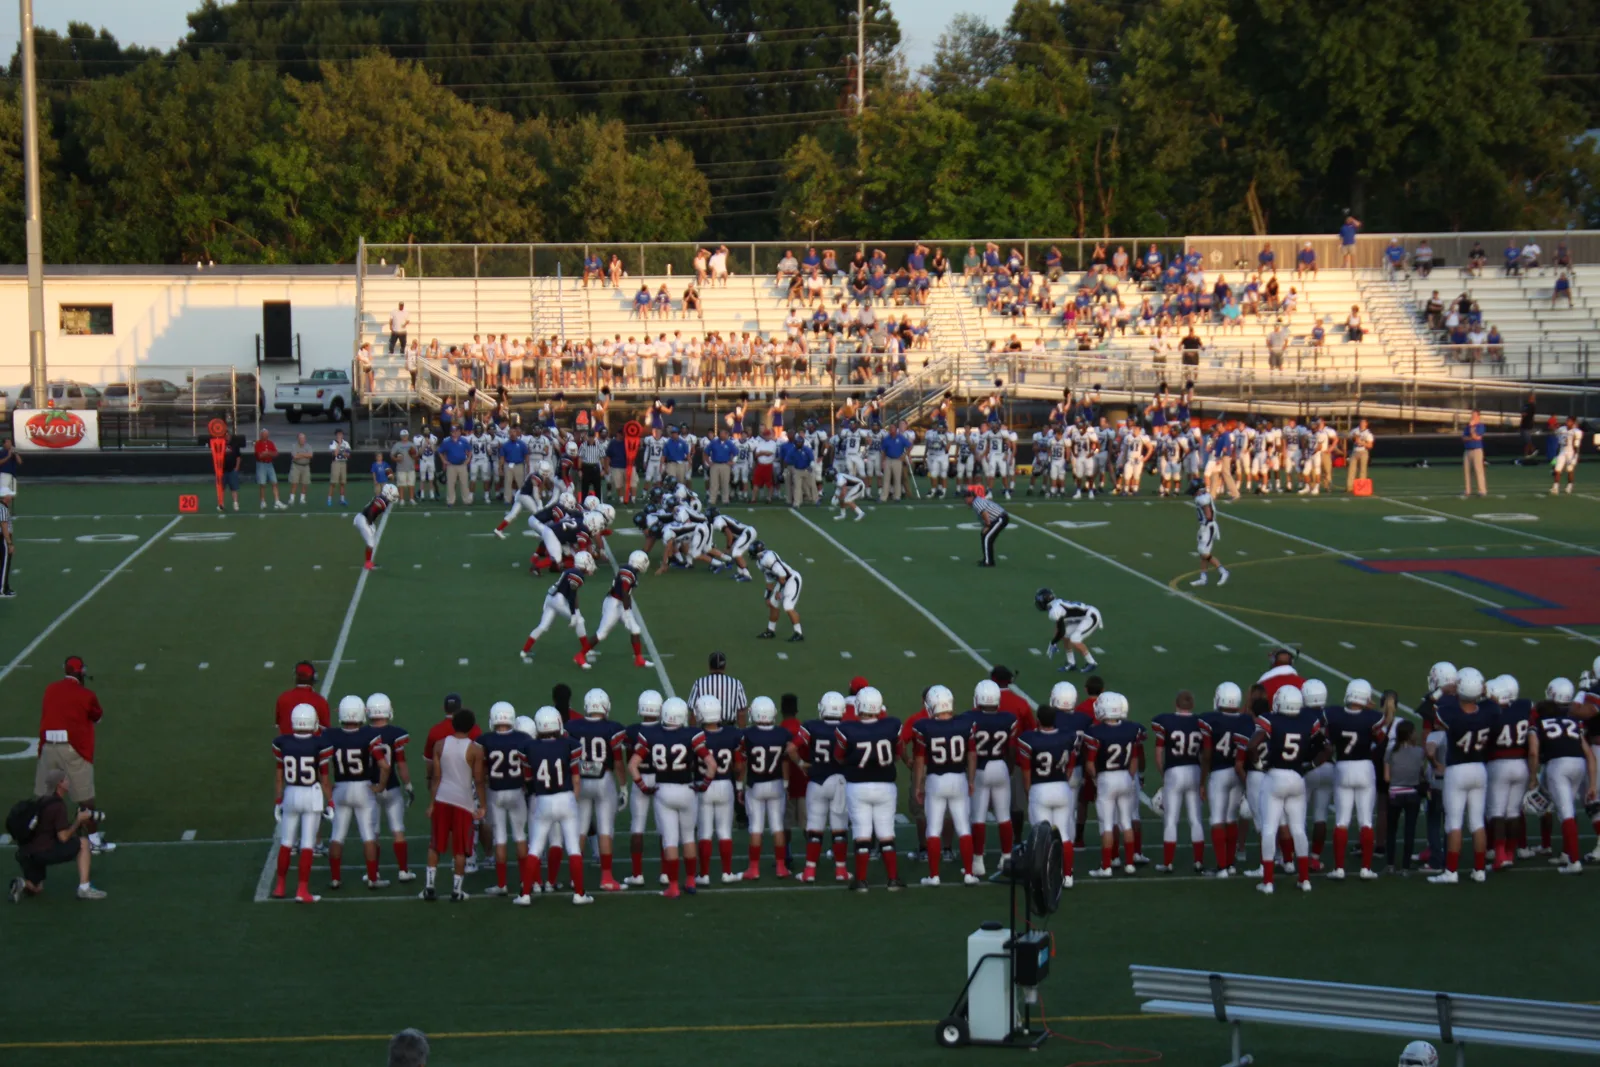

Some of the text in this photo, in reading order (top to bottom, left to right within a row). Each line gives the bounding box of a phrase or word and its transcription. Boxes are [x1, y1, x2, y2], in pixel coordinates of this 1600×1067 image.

[182, 497, 195, 508] 20
[1341, 730, 1358, 754] 7
[1457, 726, 1490, 753] 45
[1541, 718, 1580, 739] 52
[652, 743, 687, 770] 82
[856, 738, 893, 768] 70
[931, 735, 965, 764] 50
[975, 730, 1008, 756] 22
[1281, 733, 1302, 761] 5
[283, 755, 316, 785] 85
[335, 748, 364, 775] 15
[489, 750, 522, 778] 29
[536, 758, 564, 788] 41
[751, 746, 782, 773] 37
